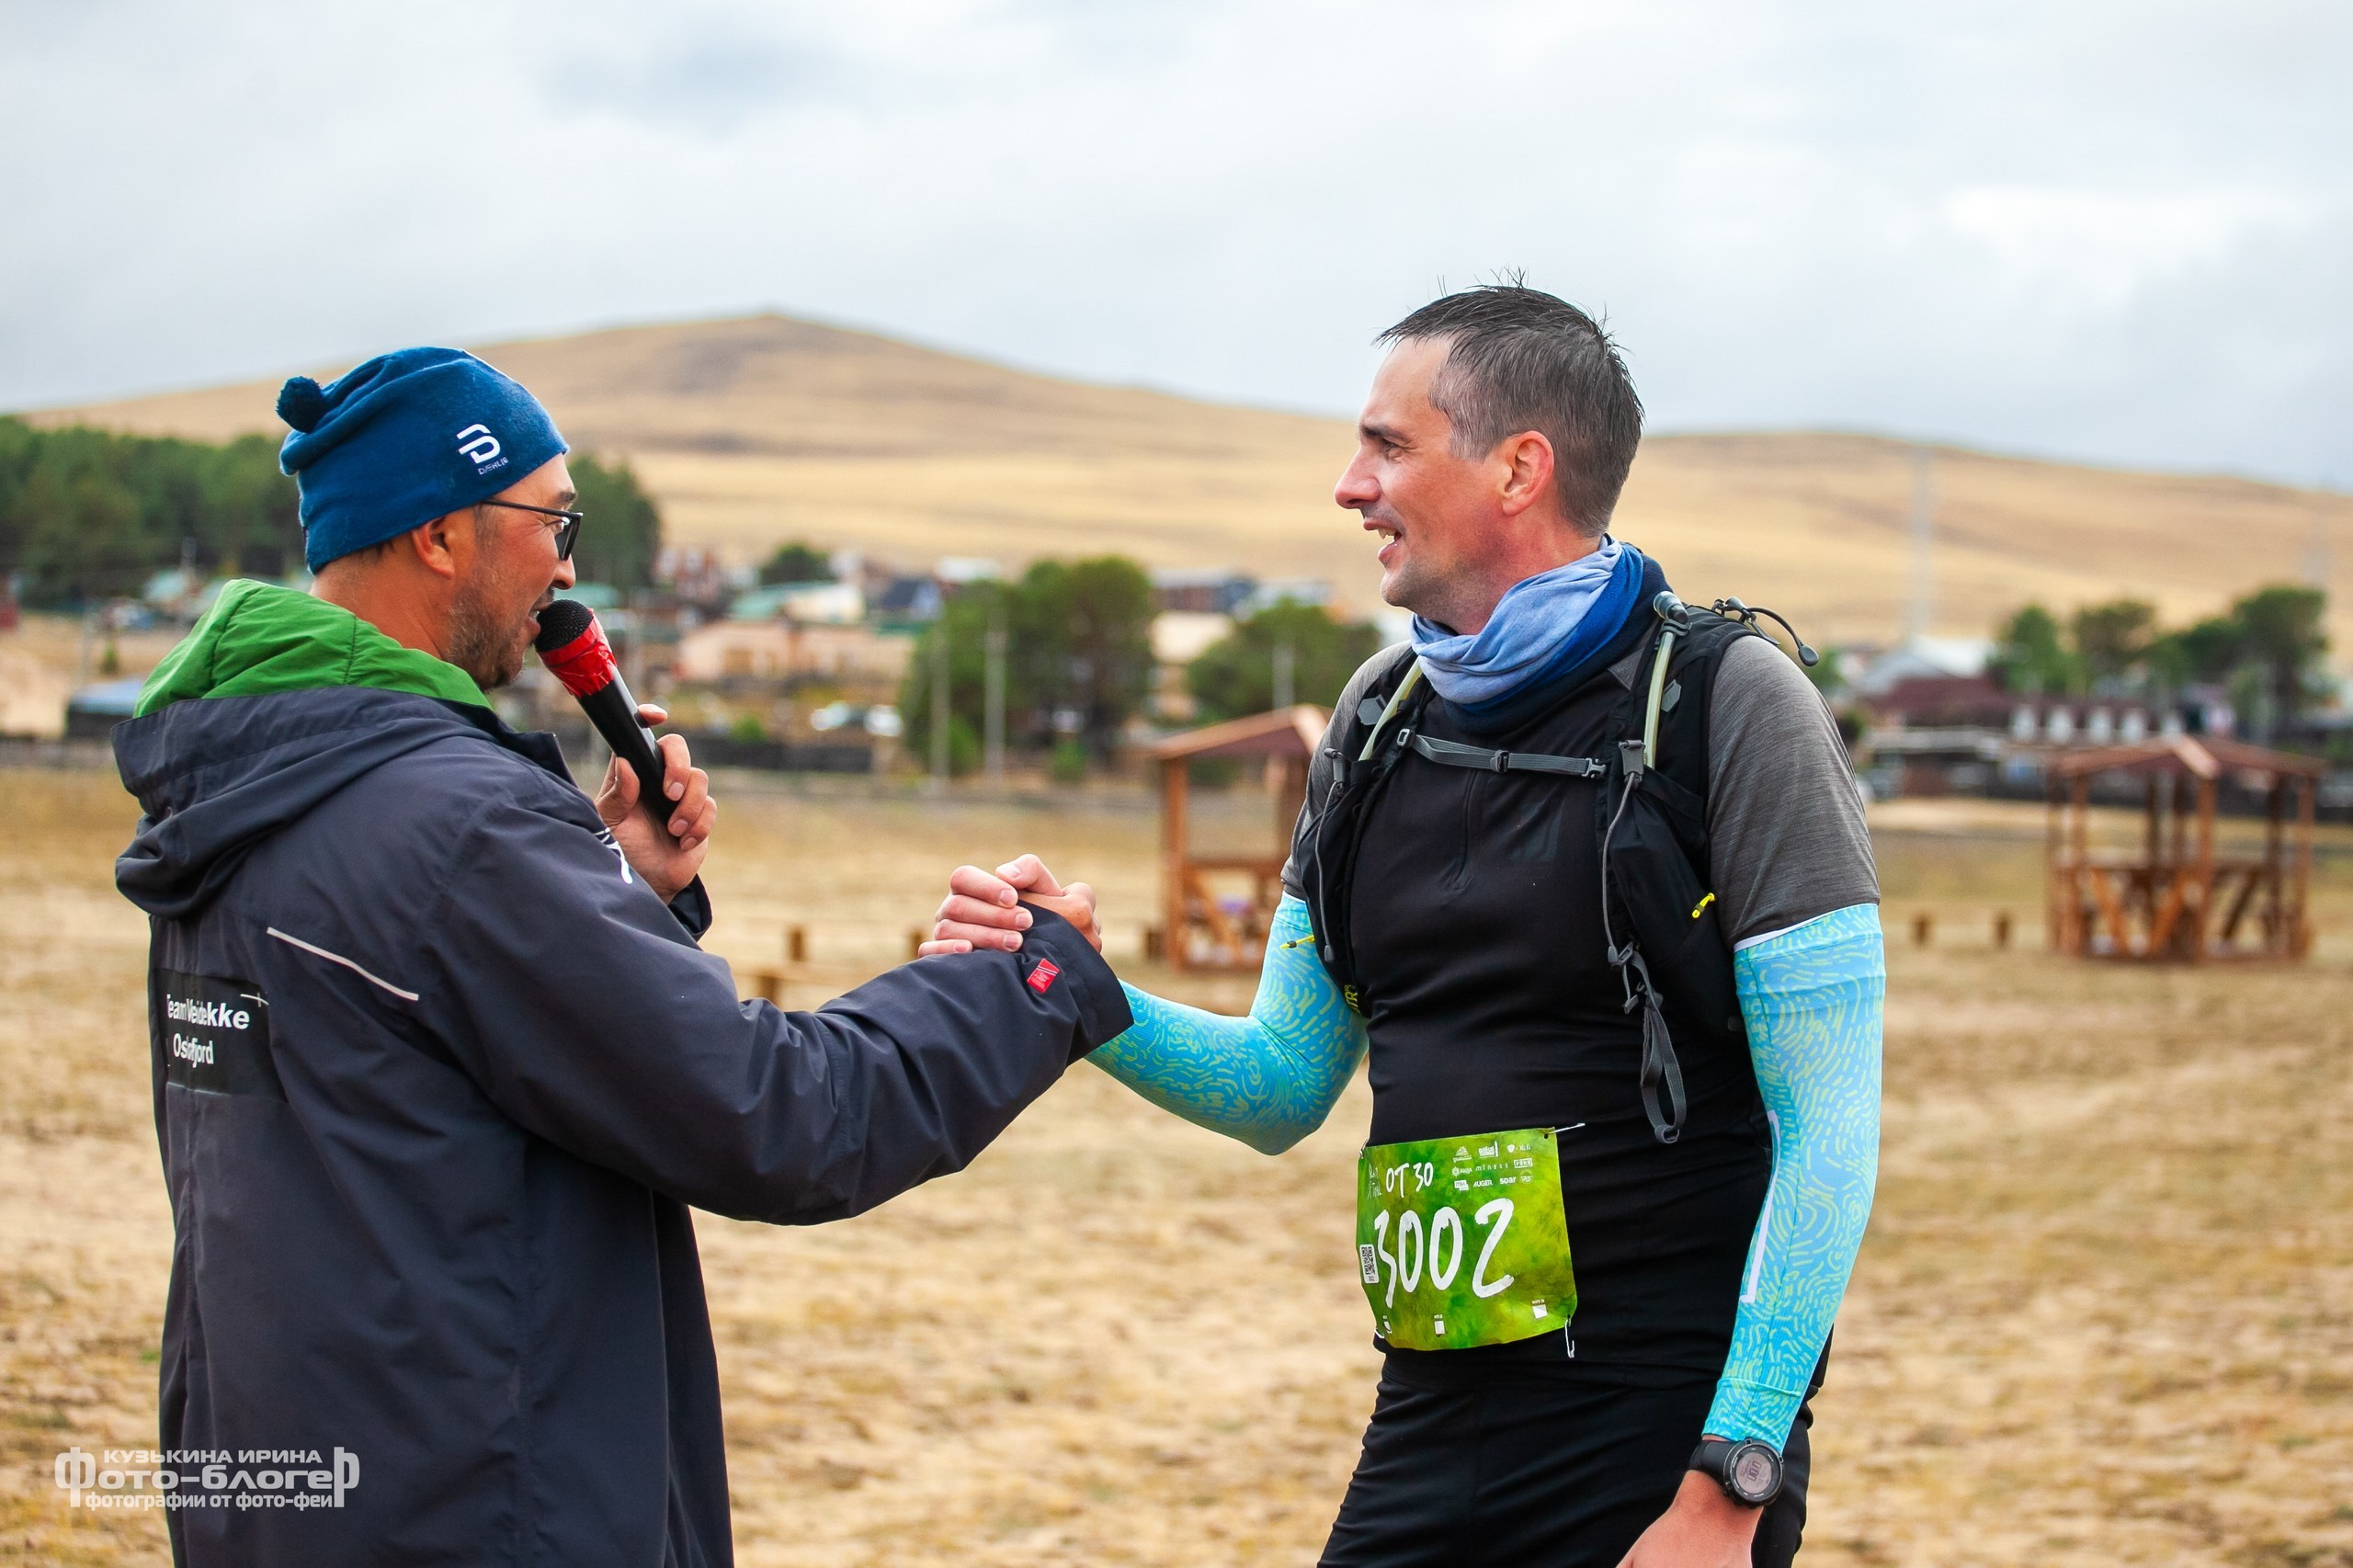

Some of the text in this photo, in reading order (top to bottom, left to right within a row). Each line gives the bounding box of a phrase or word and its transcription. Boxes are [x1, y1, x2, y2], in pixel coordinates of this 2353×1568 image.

[1385, 1162, 1410, 1199] OT
[1412, 1162, 1434, 1193] 30
[1374, 1197, 1516, 1310] 3002
